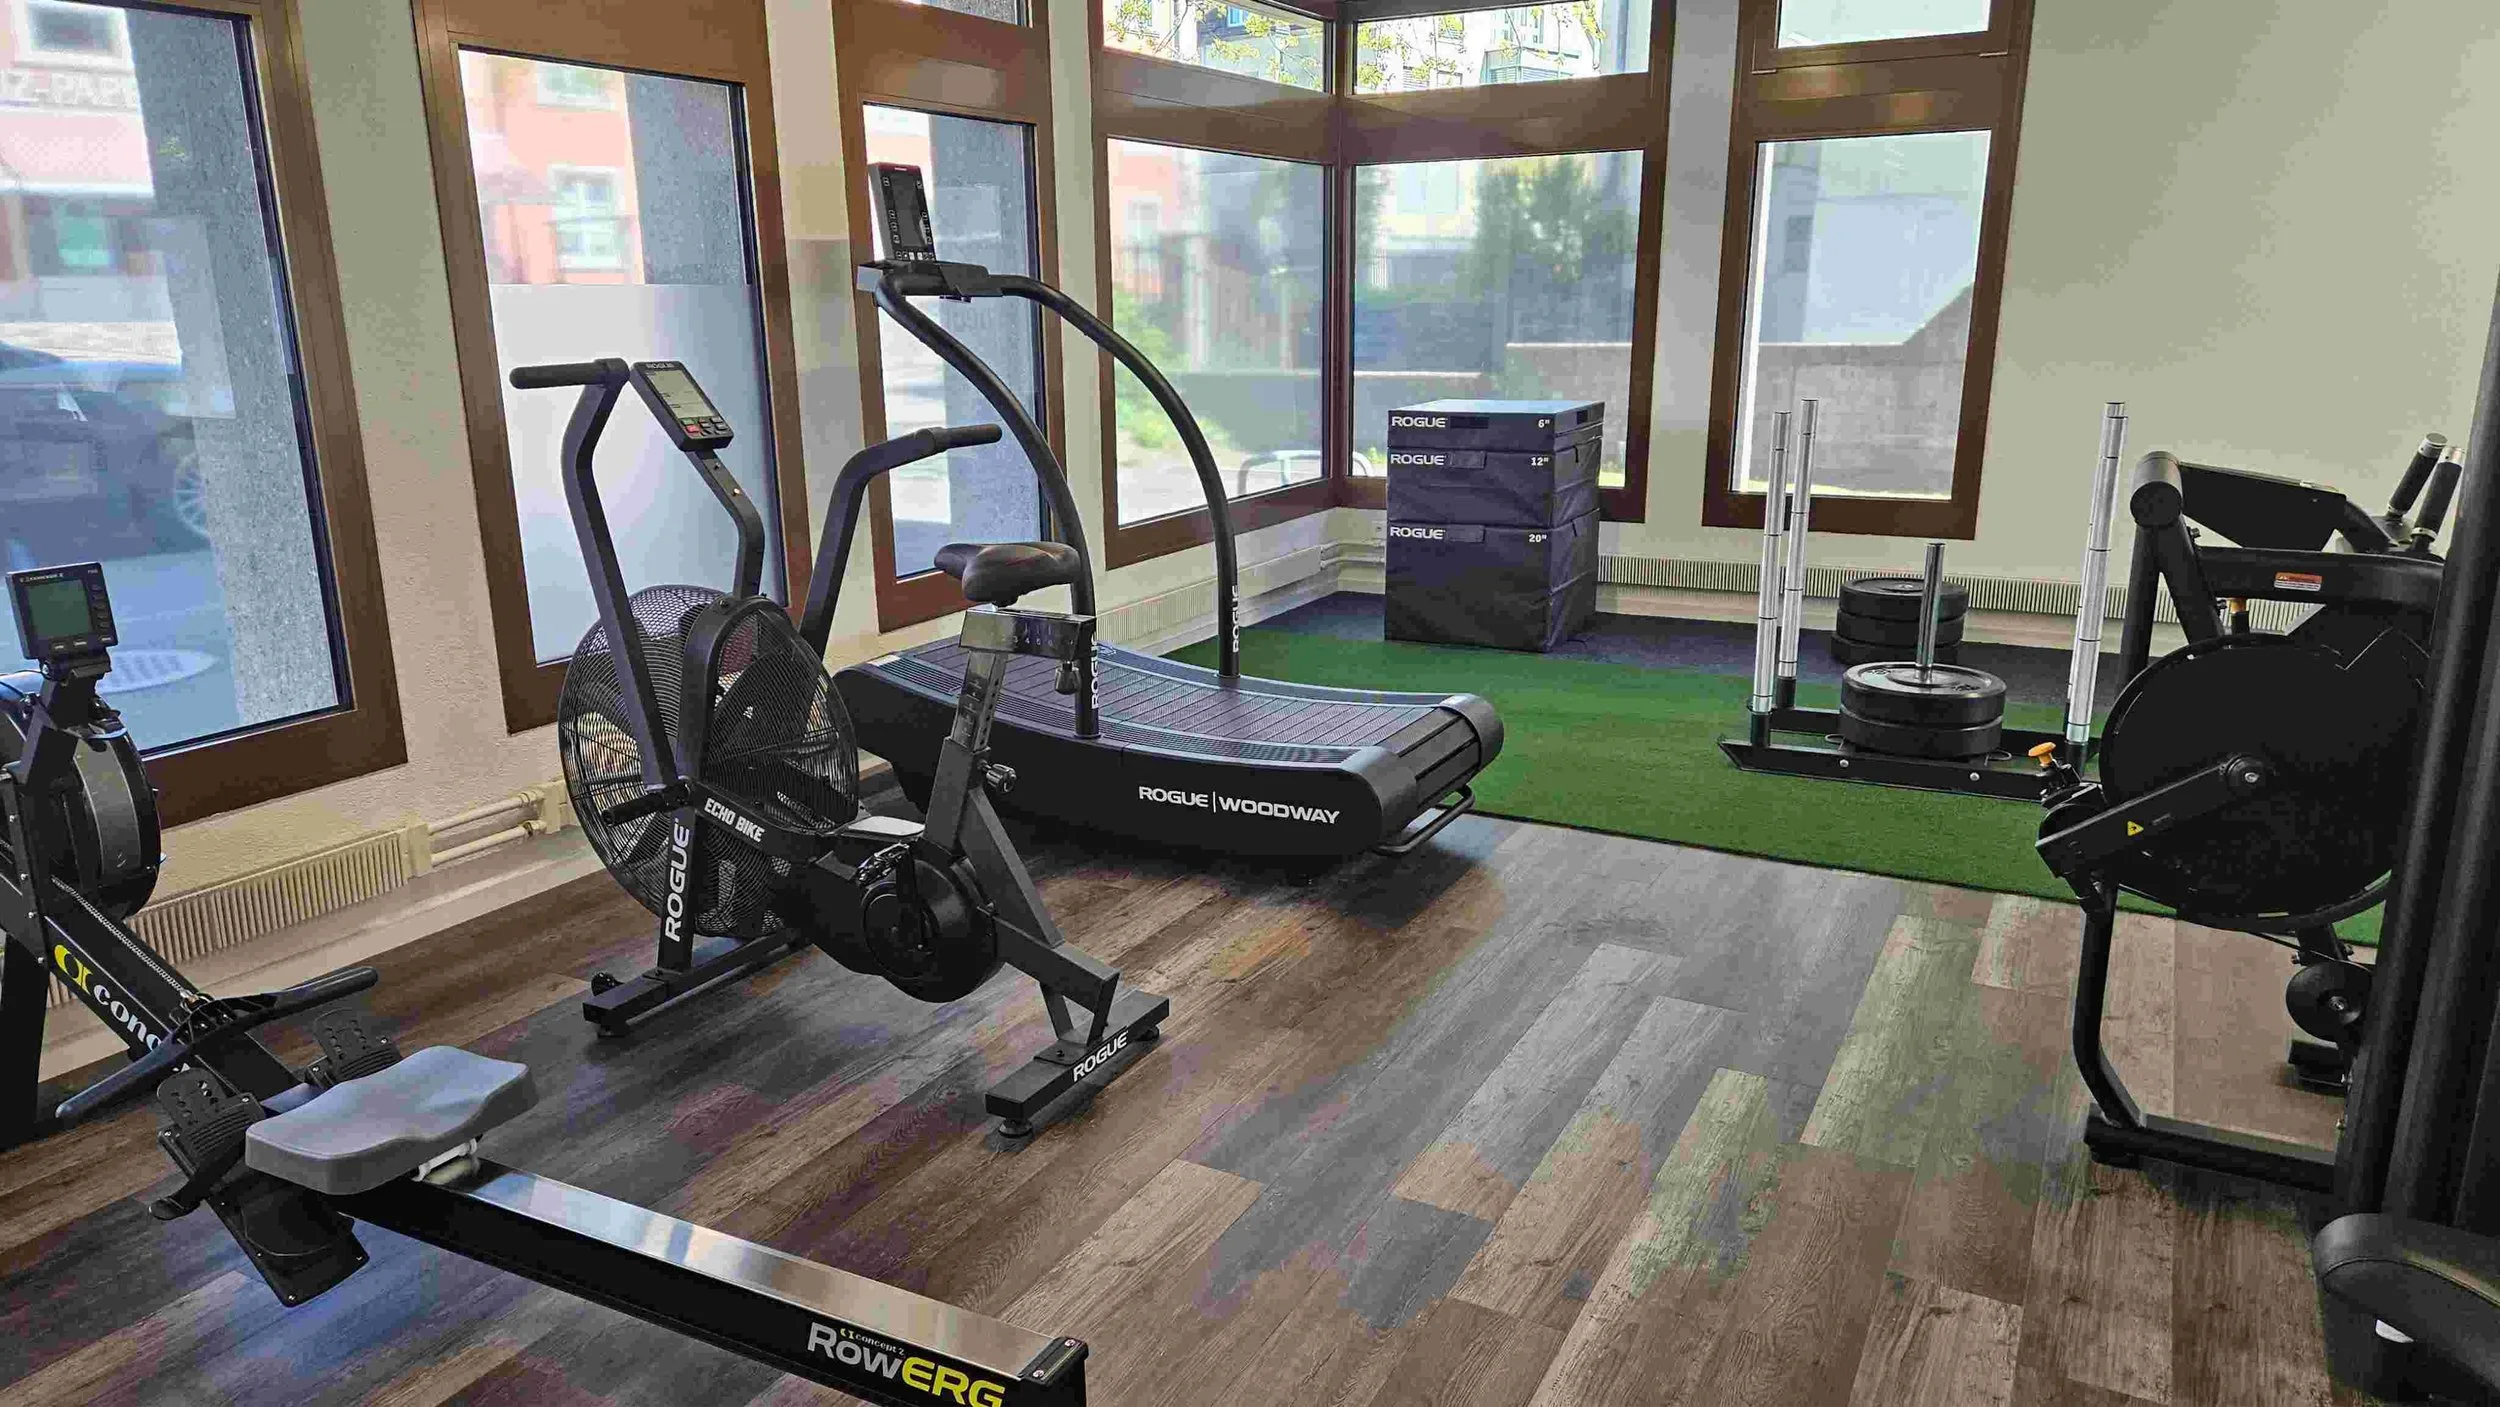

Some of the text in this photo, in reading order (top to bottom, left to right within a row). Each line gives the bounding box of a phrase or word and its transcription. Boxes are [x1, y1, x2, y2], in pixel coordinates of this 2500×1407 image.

[1391, 416, 1447, 428] ROGUE
[1390, 454, 1446, 466] ROGUE
[1390, 526, 1445, 539] ROGUE
[1138, 786, 1340, 824] ROGUE WOODWAY
[704, 798, 765, 842] ECHO BIKE
[665, 821, 690, 942] ROGUE
[1073, 1031, 1128, 1082] ROGUE
[855, 1334, 897, 1353] concept
